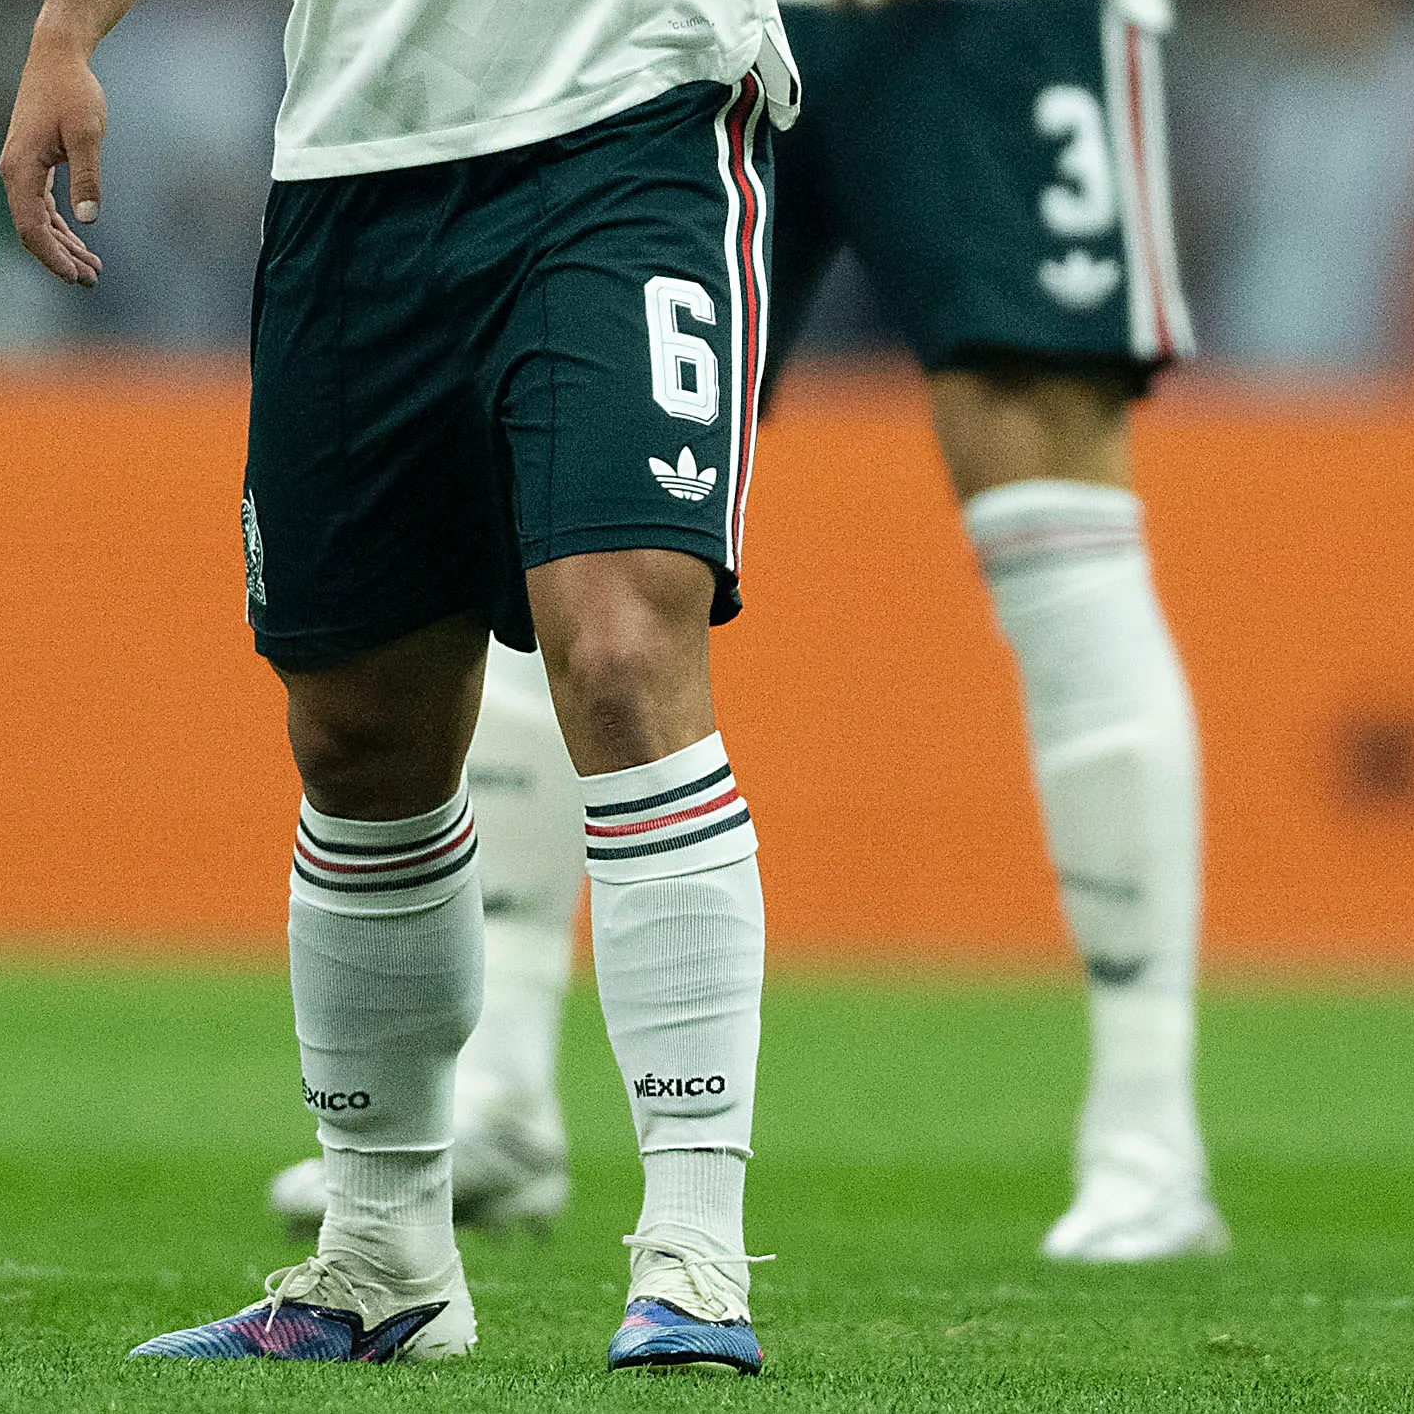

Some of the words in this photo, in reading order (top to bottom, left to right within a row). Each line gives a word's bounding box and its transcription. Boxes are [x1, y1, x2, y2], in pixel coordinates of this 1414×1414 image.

[1034, 84, 1120, 238] 3
[643, 275, 720, 426] 6
[301, 1076, 371, 1111] XICO
[633, 1072, 726, 1099] MÉXICO
